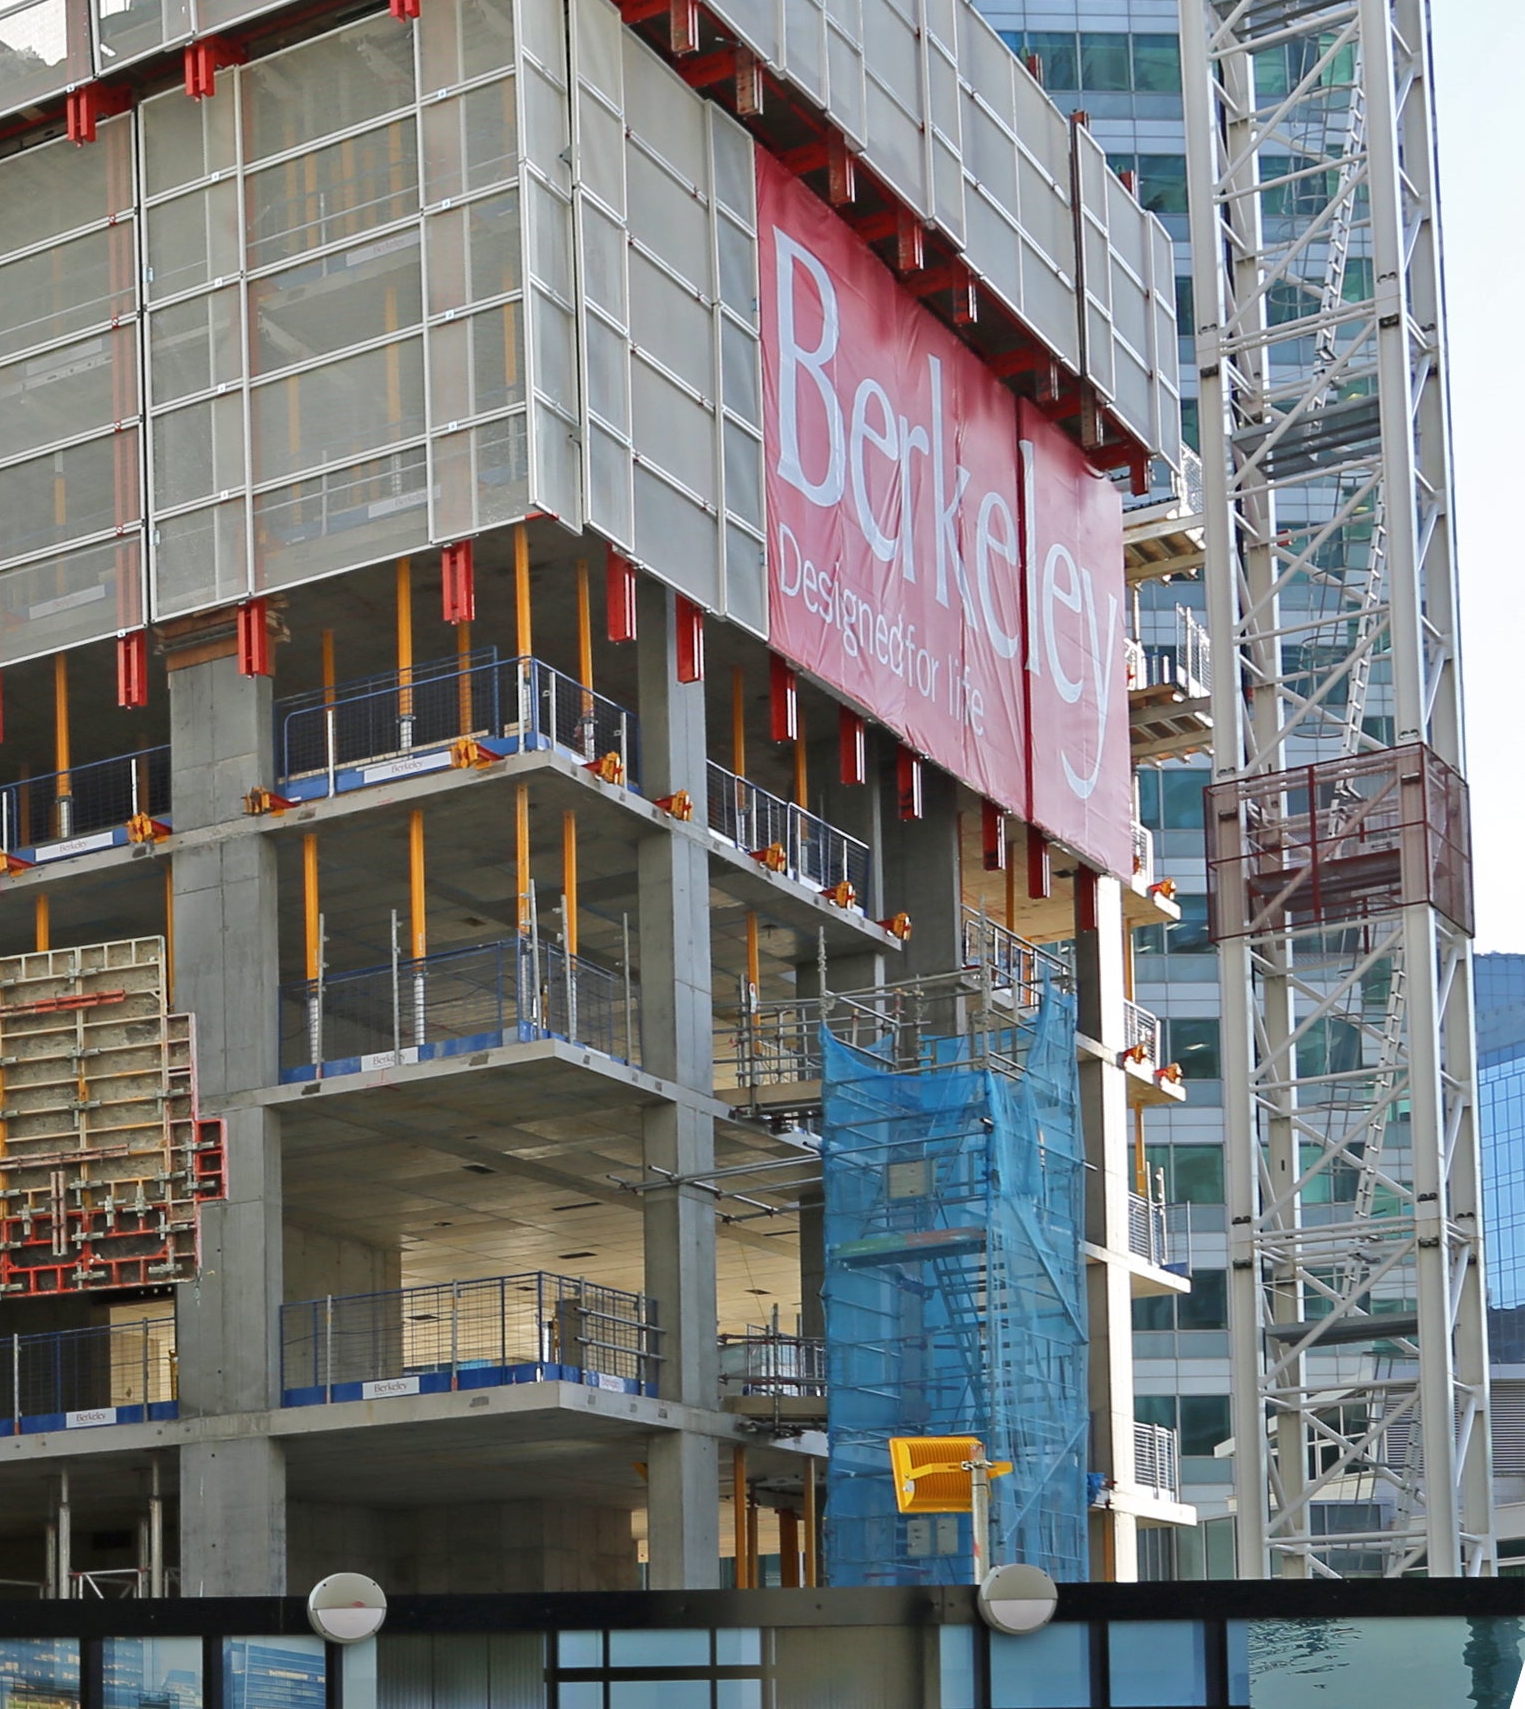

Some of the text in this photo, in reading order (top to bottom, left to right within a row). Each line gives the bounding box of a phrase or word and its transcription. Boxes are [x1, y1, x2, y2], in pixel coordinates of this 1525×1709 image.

[772, 225, 1119, 799] Berkeley
[778, 524, 985, 737] Designed for life
[392, 760, 423, 774] Berkeley
[374, 1382, 408, 1394] Berkeley
[76, 1411, 106, 1422] Berkeley
